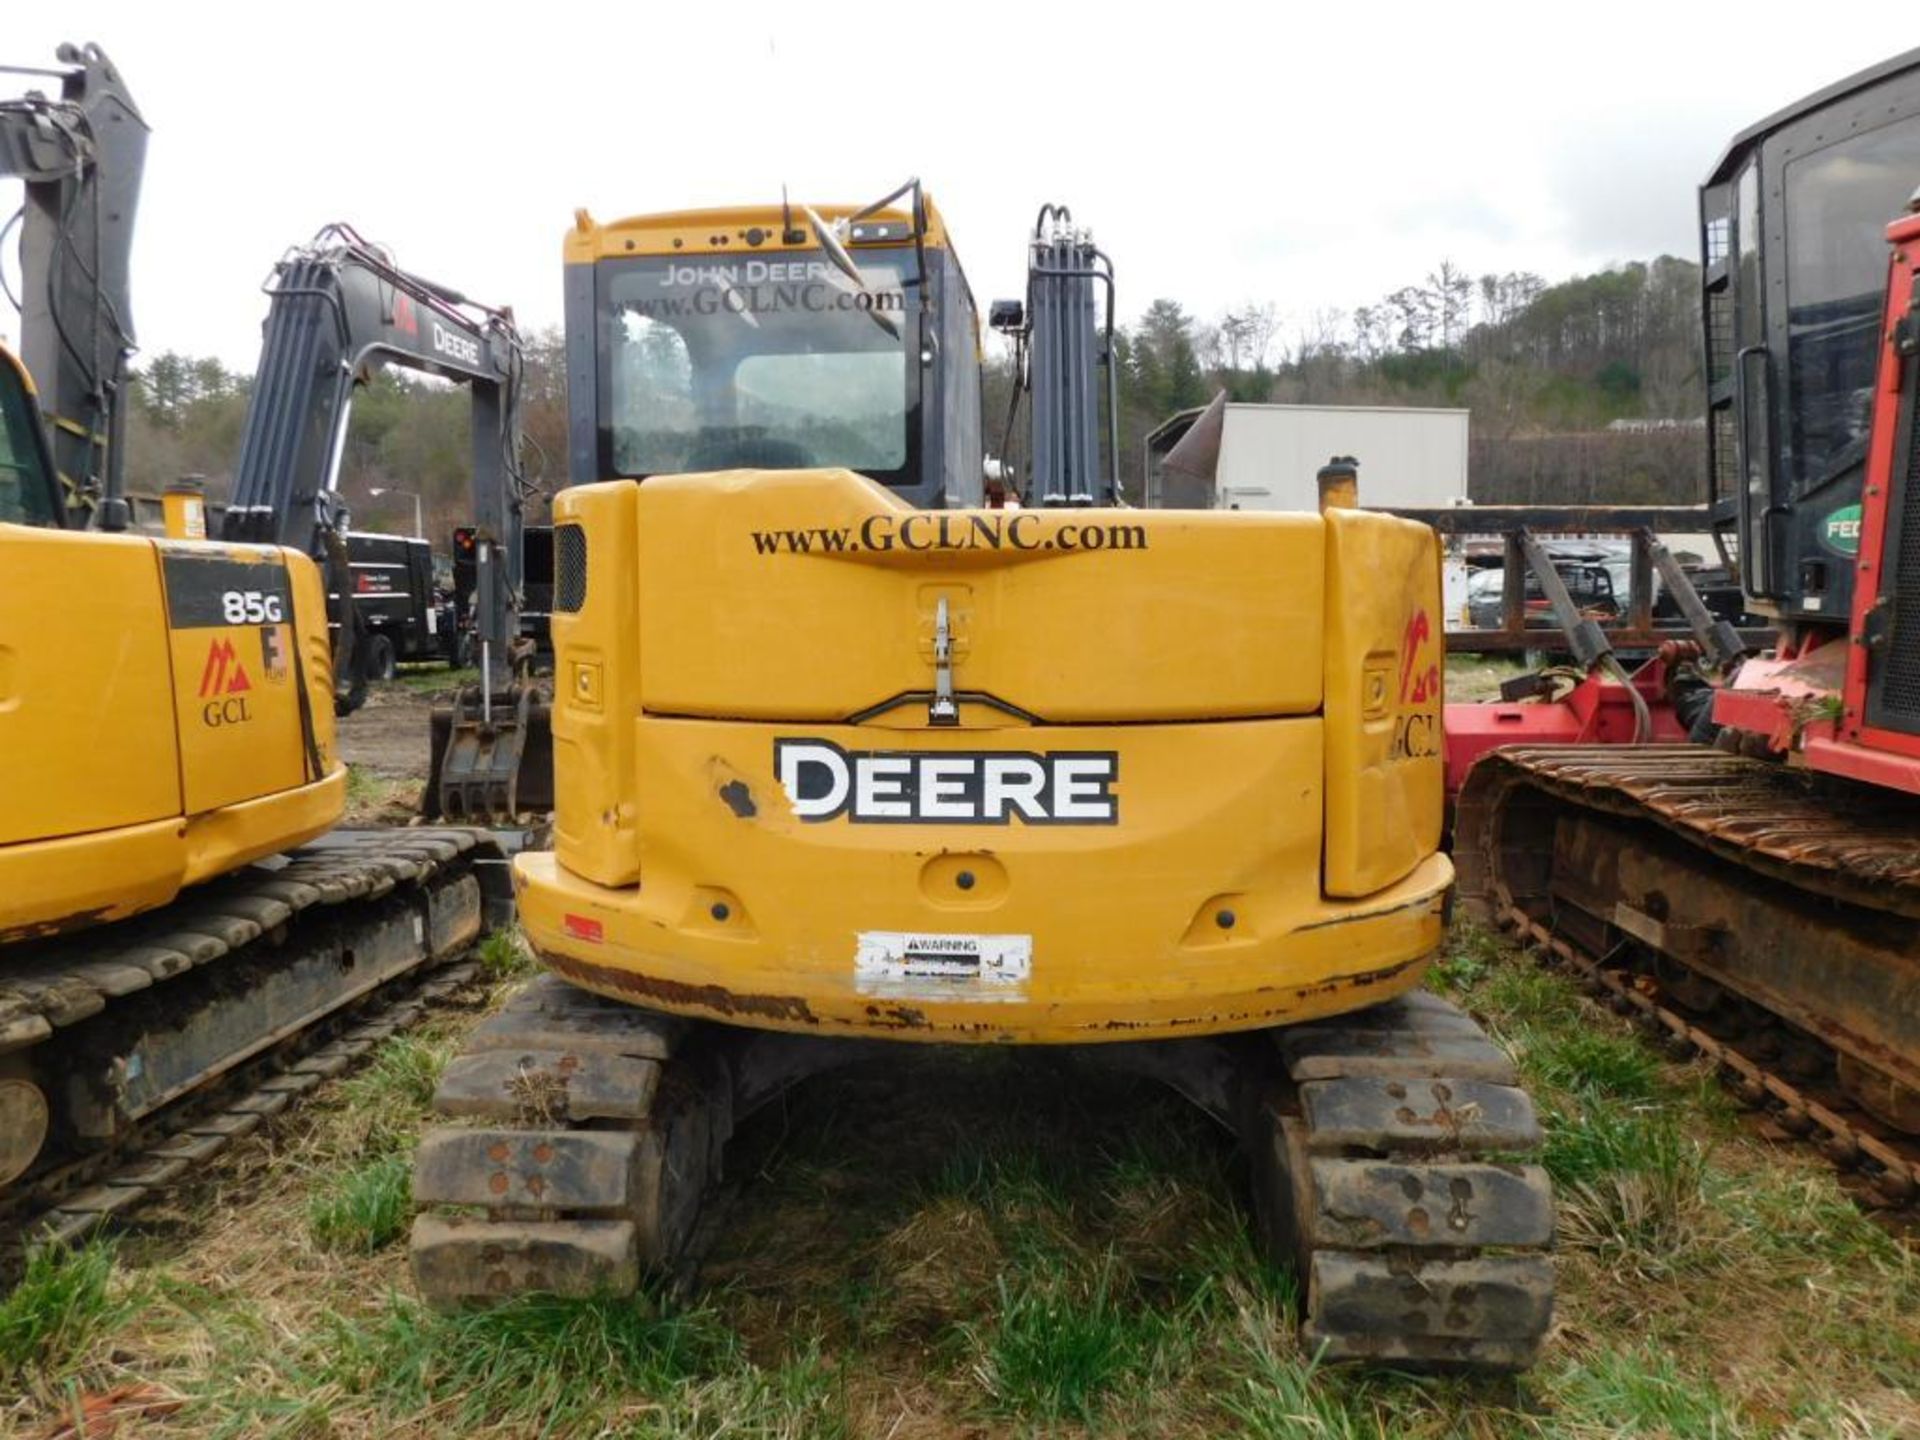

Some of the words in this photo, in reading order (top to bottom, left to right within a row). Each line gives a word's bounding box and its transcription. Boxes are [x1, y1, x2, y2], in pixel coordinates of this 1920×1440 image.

[660, 264, 738, 287] JOHN
[746, 261, 838, 283] DEER
[433, 321, 480, 366] DEERE
[751, 514, 1149, 555] www.GCLNC.com
[222, 590, 282, 624] 85G
[203, 697, 252, 728] GCL
[780, 744, 1112, 818] DEERE
[919, 938, 978, 951] WARNING
